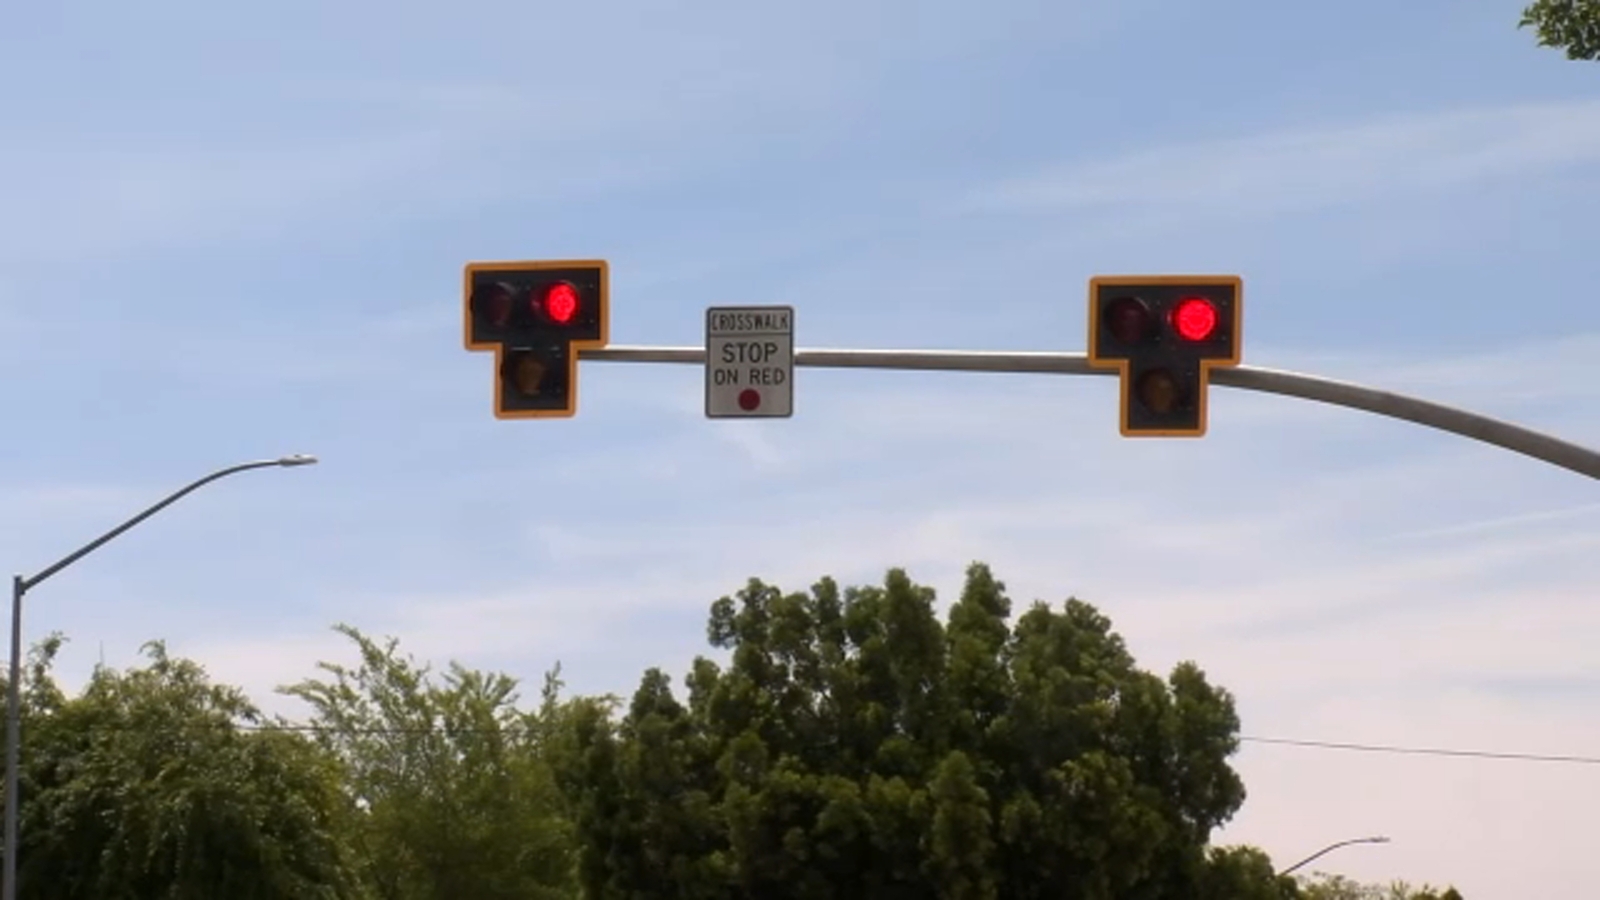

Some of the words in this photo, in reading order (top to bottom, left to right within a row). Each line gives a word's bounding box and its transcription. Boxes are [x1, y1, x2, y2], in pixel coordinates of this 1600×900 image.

[712, 313, 789, 331] CROSSWALK
[722, 342, 779, 363] STOP
[714, 368, 738, 386] ON
[749, 367, 786, 386] RED
